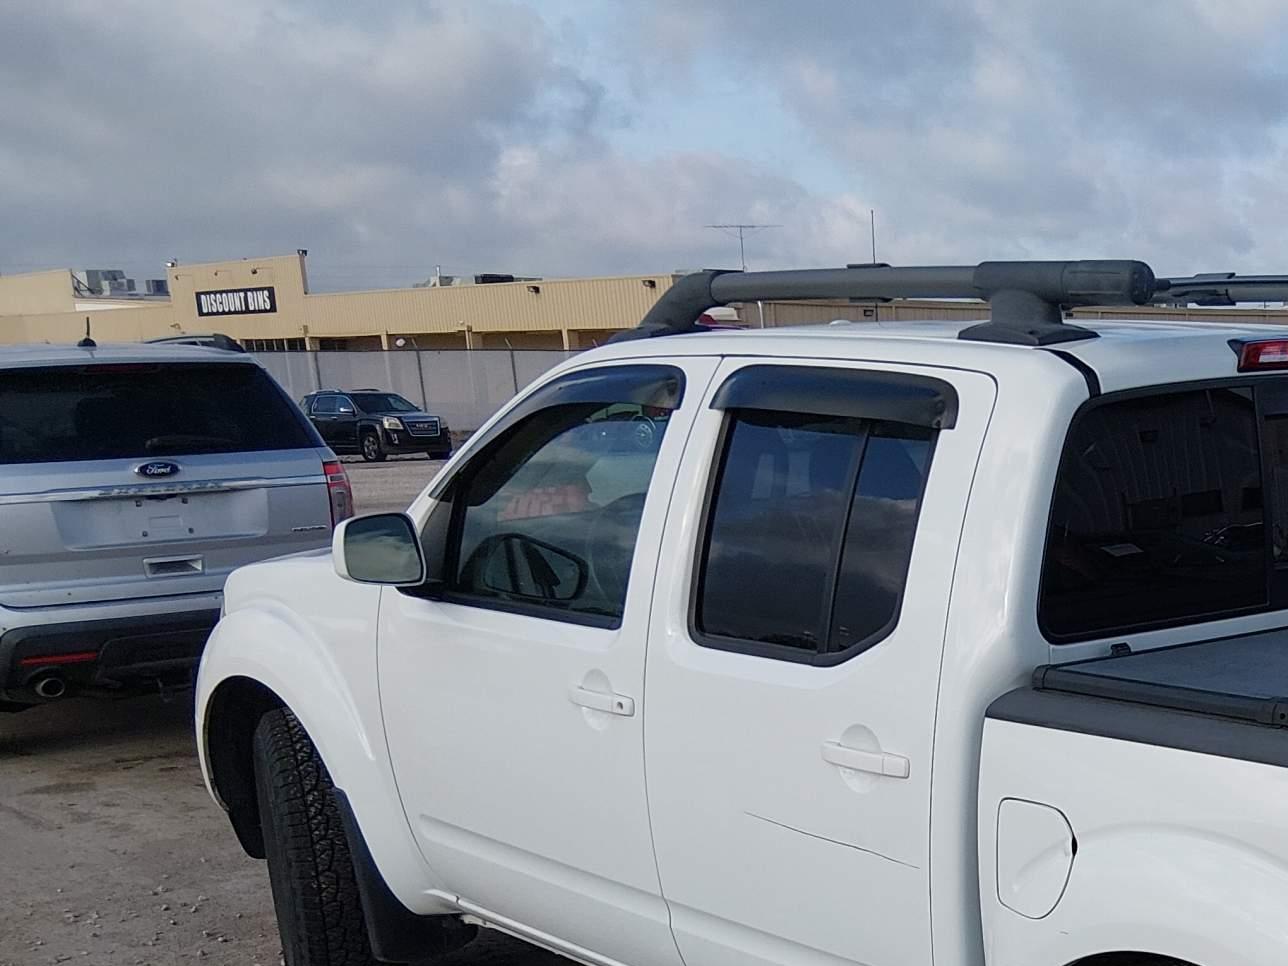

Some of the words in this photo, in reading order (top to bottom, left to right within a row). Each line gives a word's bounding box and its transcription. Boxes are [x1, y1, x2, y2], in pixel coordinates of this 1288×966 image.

[200, 292, 246, 313] DISCOUNT
[246, 289, 271, 311] BINS
[146, 463, 171, 475] Ford
